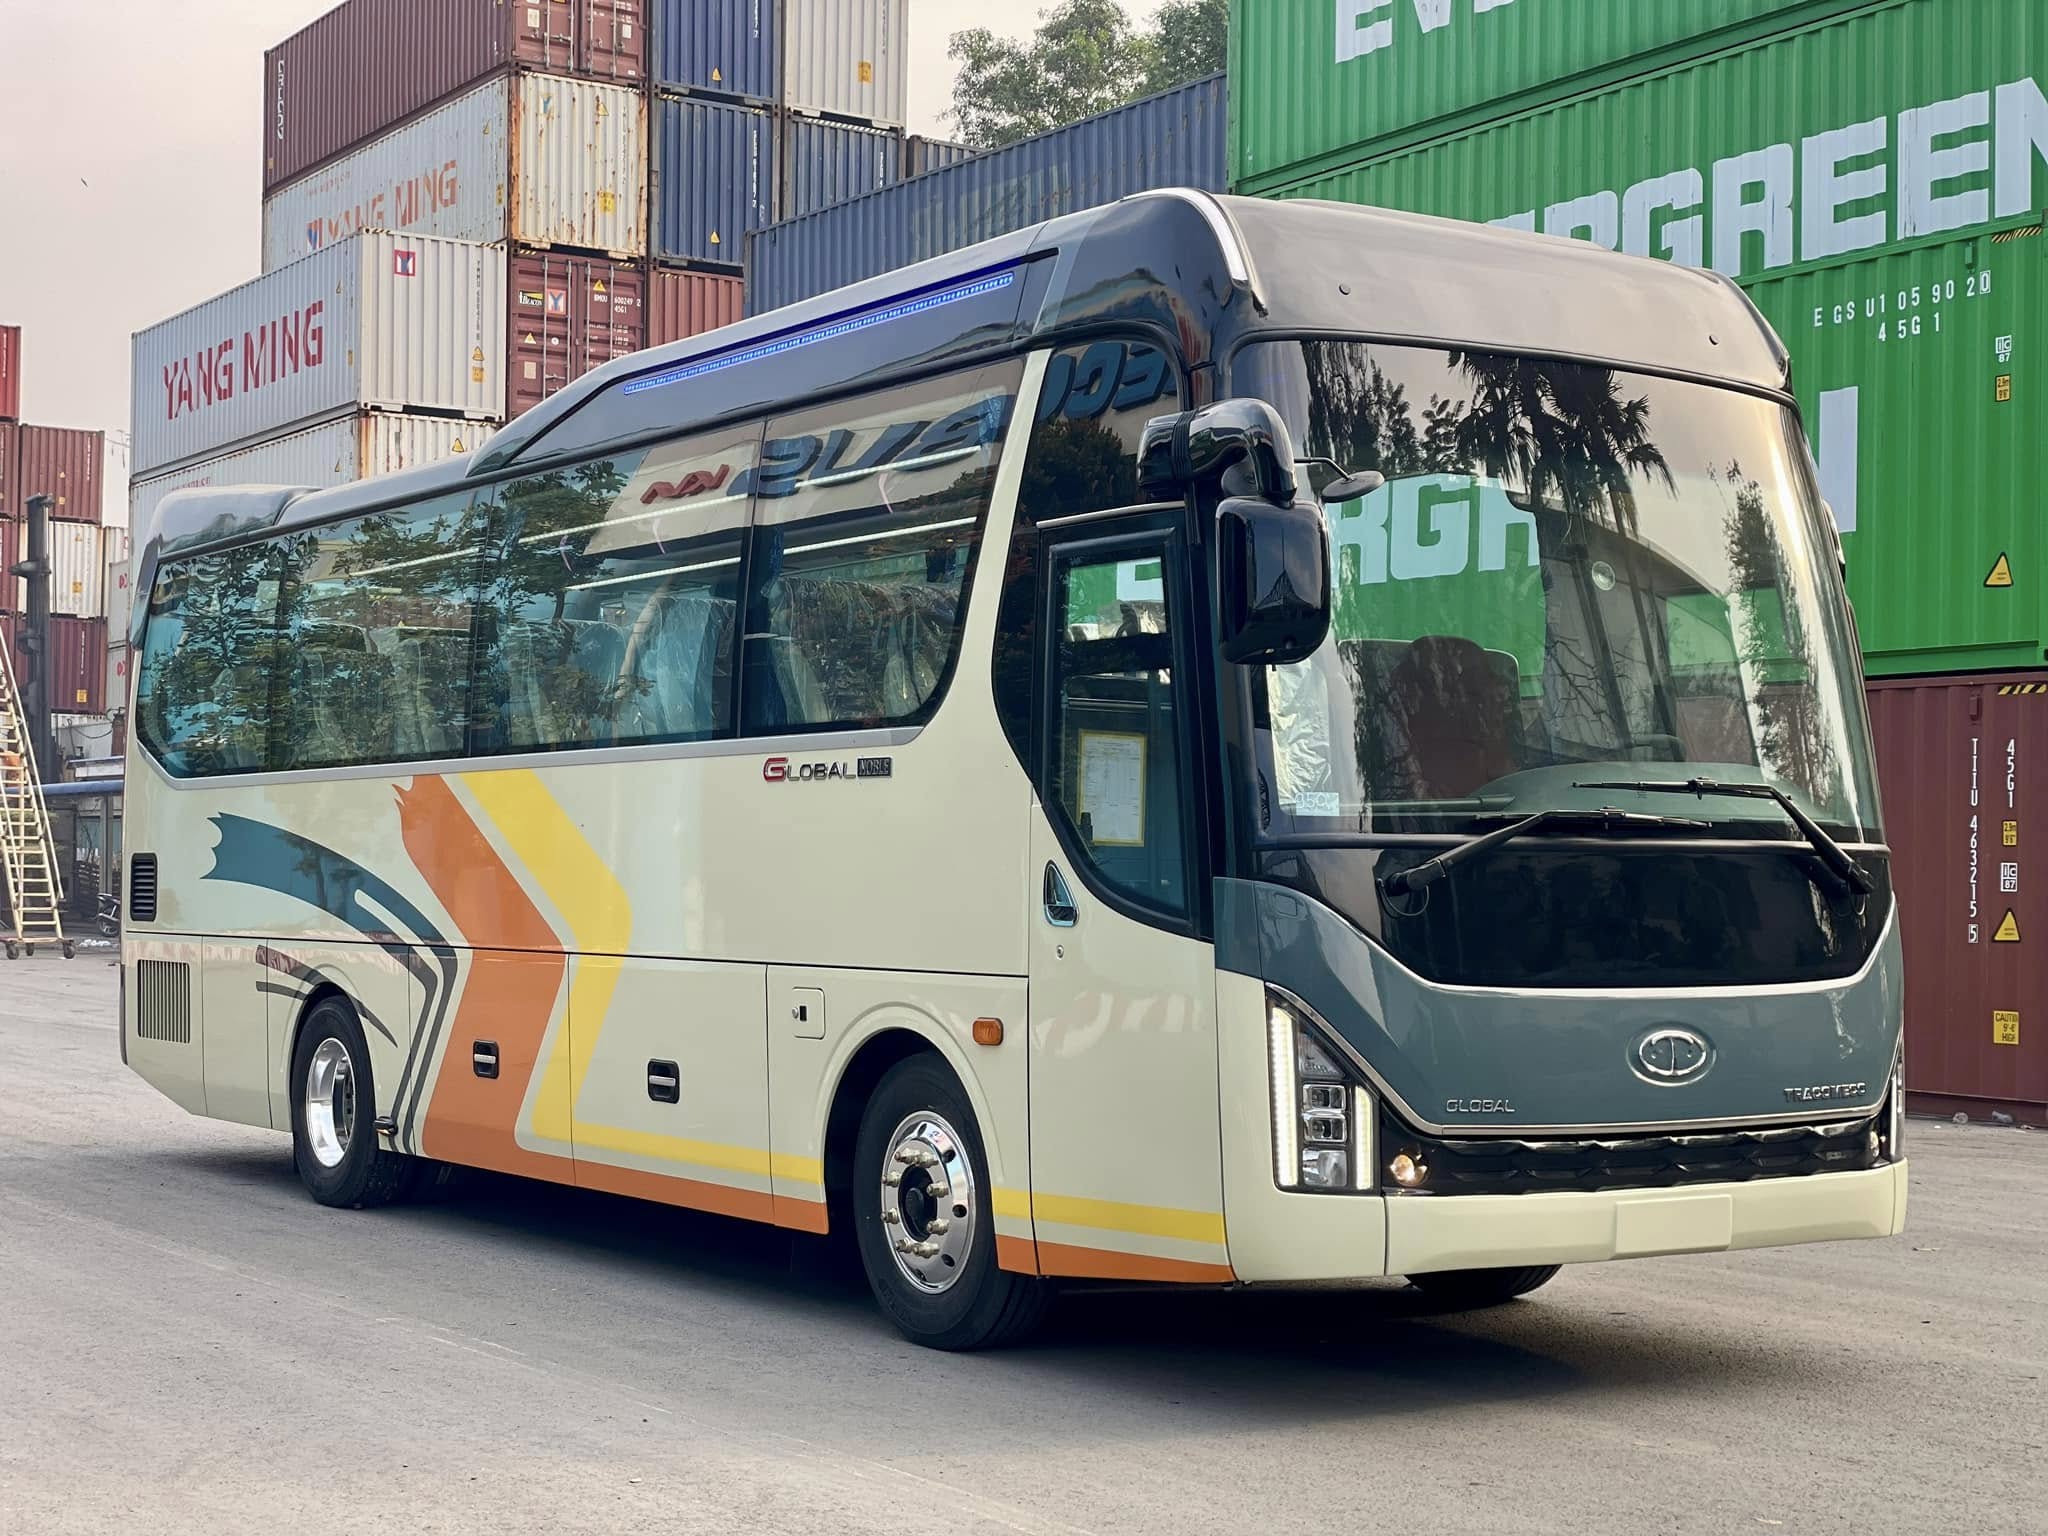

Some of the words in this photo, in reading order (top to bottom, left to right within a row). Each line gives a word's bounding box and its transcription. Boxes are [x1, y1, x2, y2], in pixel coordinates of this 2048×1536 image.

[163, 338, 234, 420] YANG
[243, 300, 323, 393] MING
[2007, 739, 2015, 808] 45G1
[1970, 815, 1978, 918] 463215
[2004, 880, 2016, 889] 87
[1969, 925, 1978, 942] 5
[1446, 1099, 1516, 1113] GLOBAL
